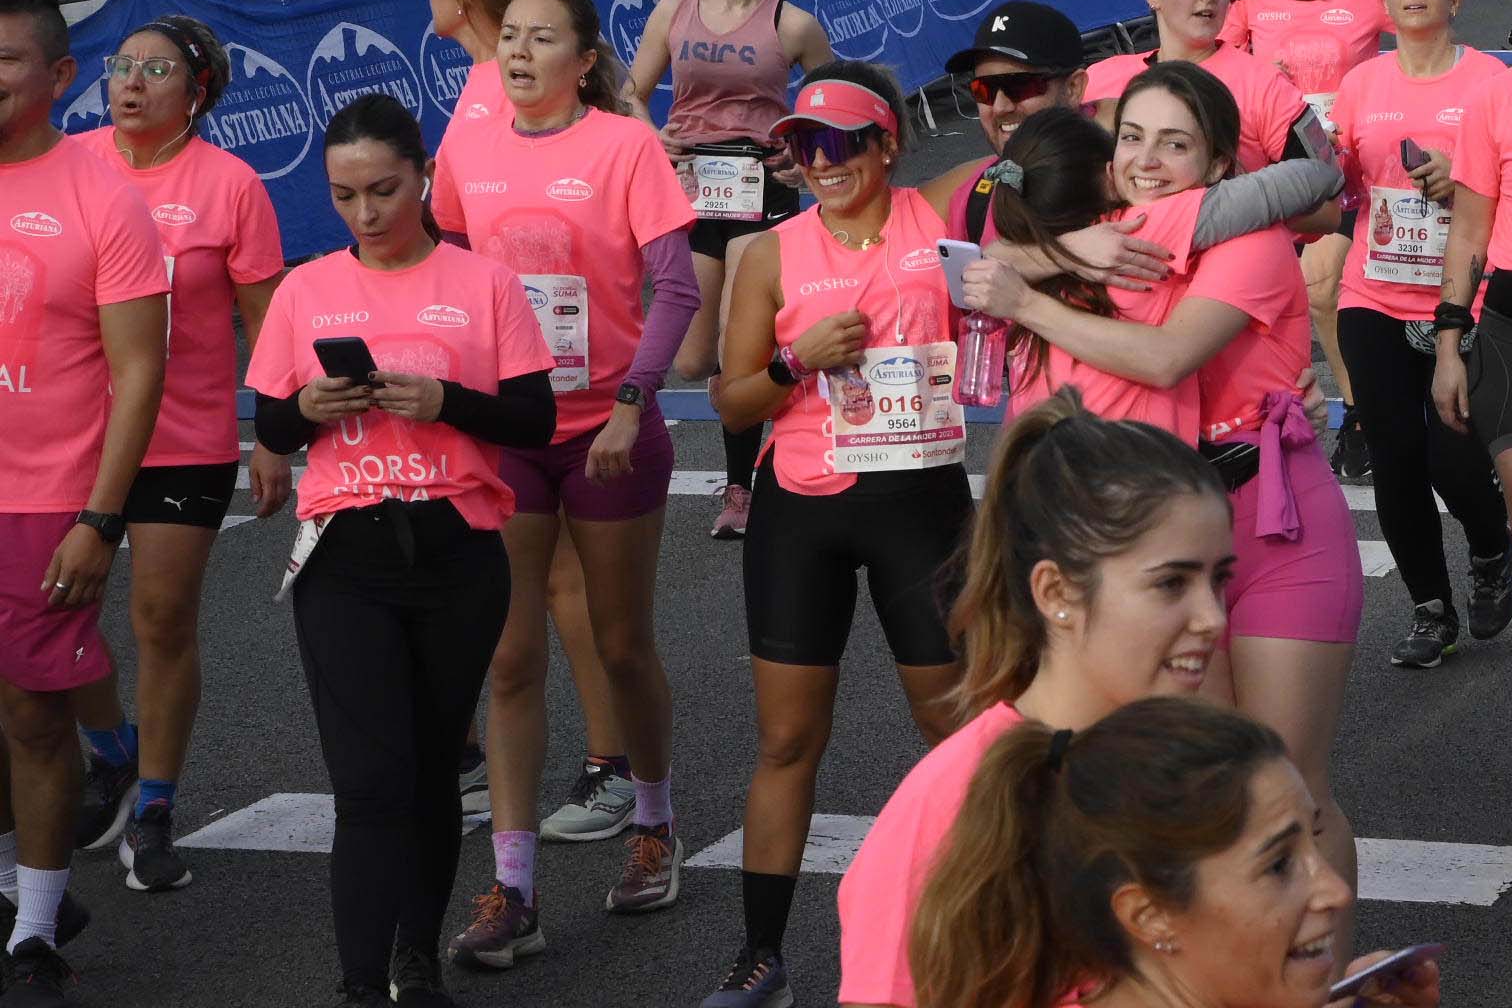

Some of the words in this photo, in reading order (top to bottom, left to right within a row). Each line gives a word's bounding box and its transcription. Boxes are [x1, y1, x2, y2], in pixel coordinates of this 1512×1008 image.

[820, 6, 885, 45] ASTURIAN
[441, 48, 468, 65] CENTR
[328, 67, 363, 86] CENTRAL
[365, 60, 402, 79] LECHERA
[207, 100, 308, 151] ASTURIANA
[465, 182, 507, 194] OYSHO
[702, 185, 733, 199] 016
[704, 200, 729, 209] 29251
[15, 218, 58, 235] ASTURIANA
[1396, 226, 1428, 241] 016
[1398, 243, 1424, 254] 32301
[552, 290, 578, 298] SUMA
[800, 278, 858, 296] OYSHO
[311, 311, 370, 328] OYSHO
[557, 358, 575, 366] 2023
[879, 395, 923, 413] 016
[887, 418, 917, 430] 9564
[849, 435, 887, 444] CARRERA
[900, 434, 912, 442] LA
[847, 452, 889, 464] OYSHO
[338, 452, 452, 485] DORSAL
